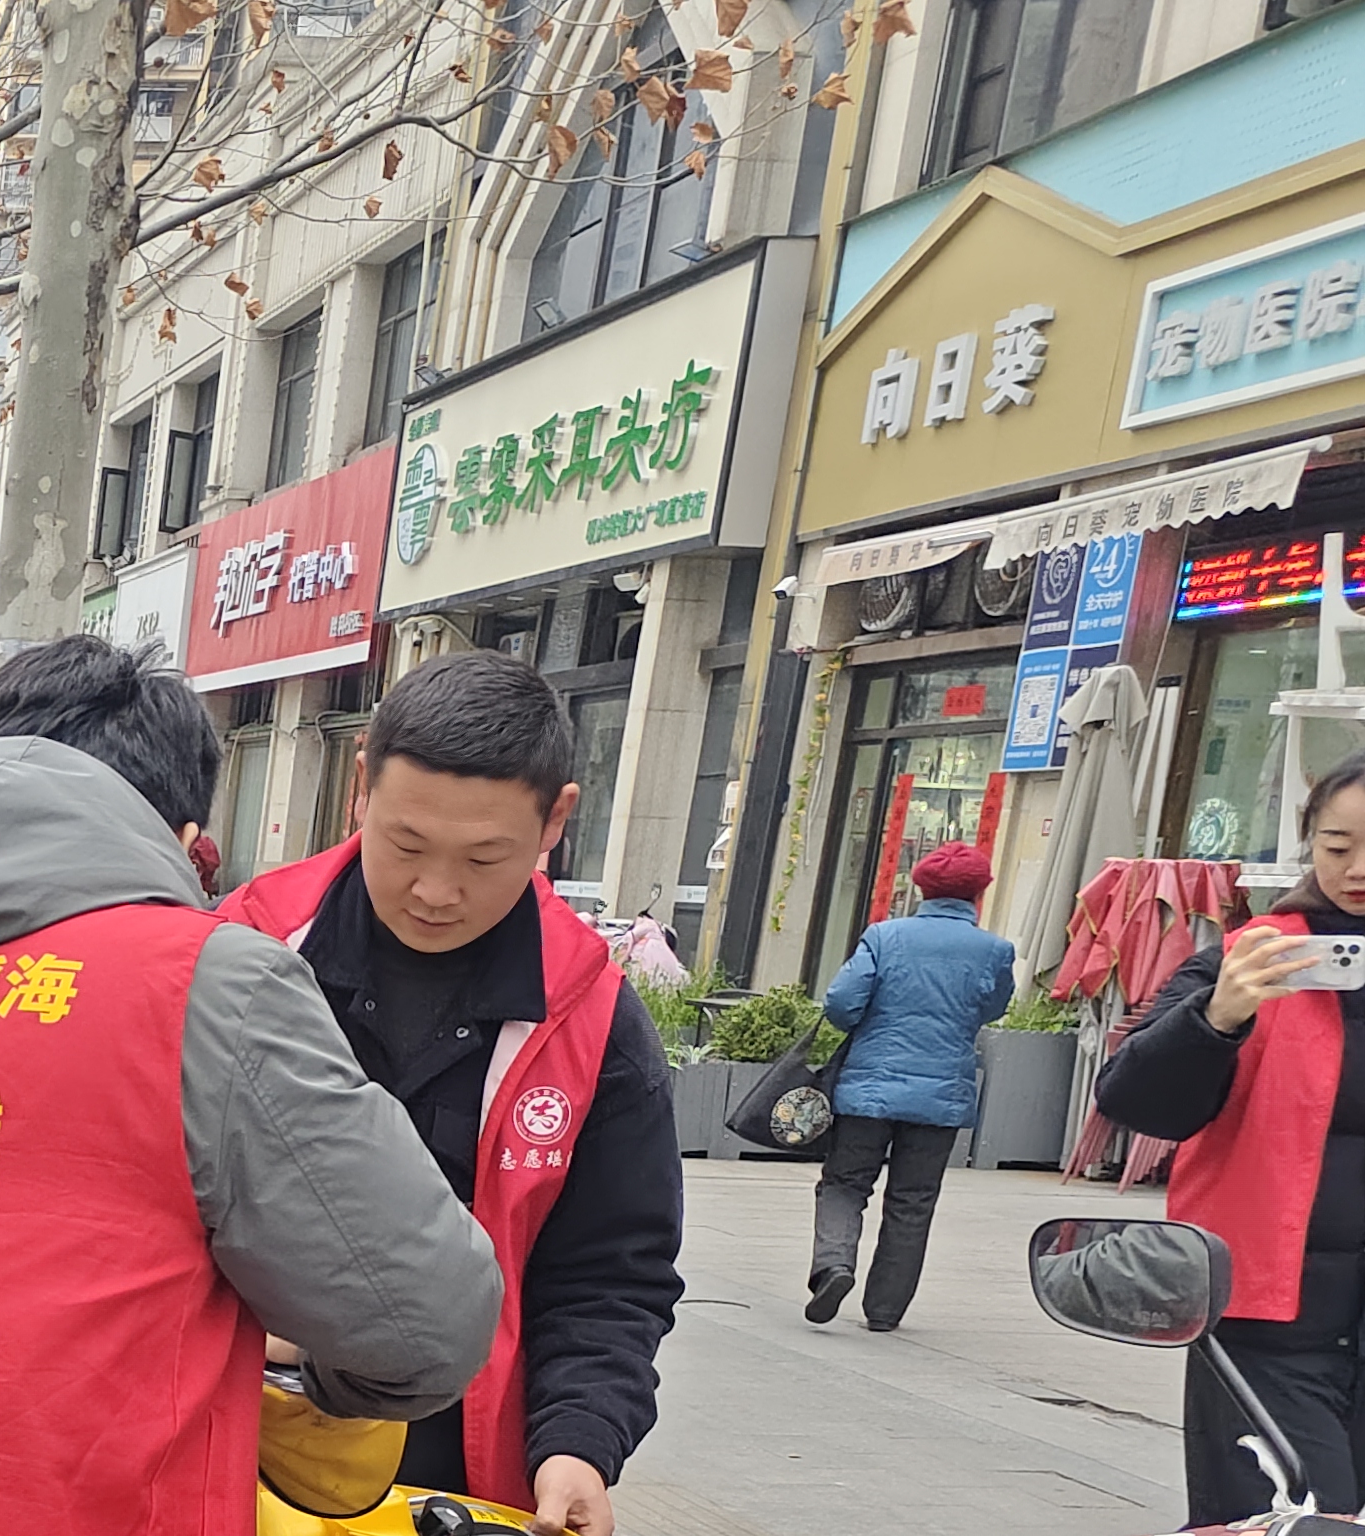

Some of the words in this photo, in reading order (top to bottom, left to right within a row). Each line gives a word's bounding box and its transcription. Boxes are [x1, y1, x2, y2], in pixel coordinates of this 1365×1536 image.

[1146, 259, 1365, 382] 宠物医院
[861, 303, 1056, 444] 向日葵
[1035, 479, 1244, 548] 向日葵宠物医院
[287, 543, 358, 604] 托管中心
[1089, 541, 1119, 579] 24
